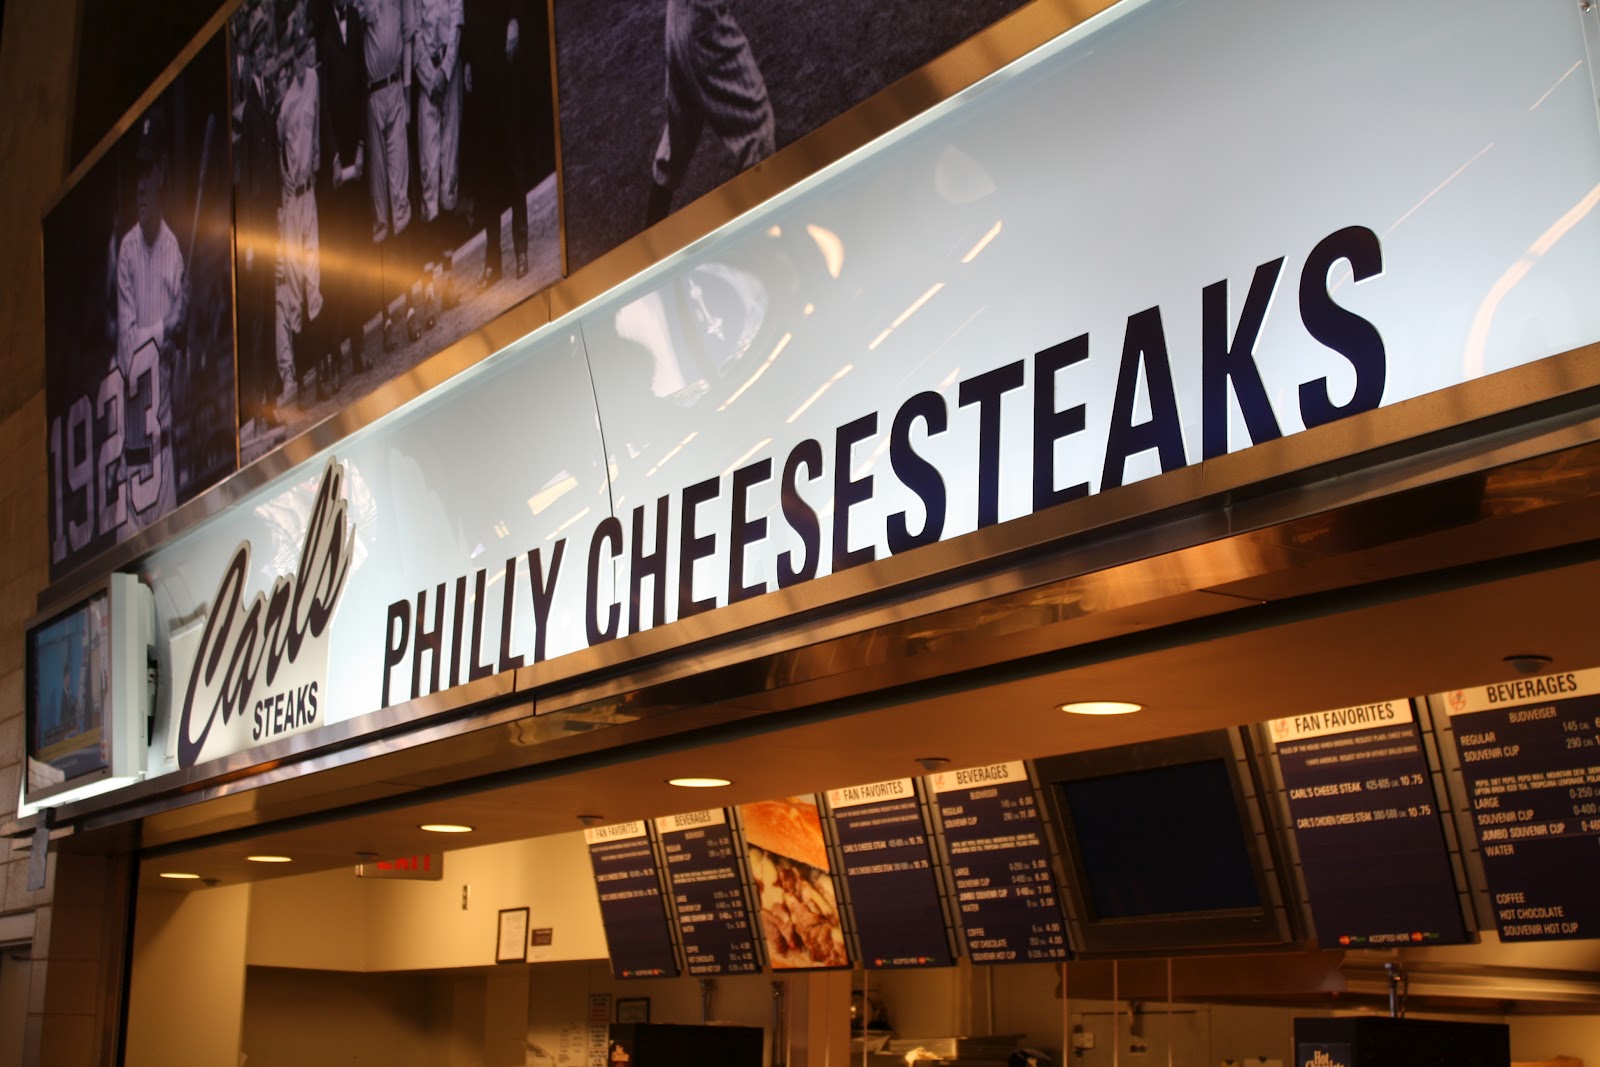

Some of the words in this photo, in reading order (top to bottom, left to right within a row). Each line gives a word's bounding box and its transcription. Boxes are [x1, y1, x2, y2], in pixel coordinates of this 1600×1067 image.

[51, 338, 161, 565] 1923
[381, 537, 567, 709] PHILLY
[586, 225, 1386, 647] CHEESESTEAKS
[178, 456, 355, 769] Carl's
[1486, 673, 1577, 703] BEVERAGES
[252, 682, 319, 741] STEAKS
[1295, 715, 1321, 733] FAN
[1324, 703, 1394, 728] FAVORITES
[1509, 706, 1557, 723] BUDWEISER
[1460, 732, 1496, 746] REGULAR
[1563, 720, 1578, 732] 145
[1464, 747, 1502, 762] SOUVENIR
[1503, 745, 1520, 757] CUP
[956, 764, 1008, 784] BEVERAGES
[843, 788, 860, 801] FAN
[861, 781, 903, 798] FAVORITES
[1290, 788, 1313, 800] CARL'S
[1314, 785, 1339, 797] CHEESE
[1340, 782, 1362, 794] STEAK
[1474, 797, 1499, 809] LARGE
[674, 810, 711, 827] BEVERAGES
[1478, 811, 1517, 825] SOUVENIR
[1518, 810, 1534, 820] CUP
[595, 828, 607, 839] FAN
[608, 822, 639, 836] FAVORITES
[1482, 829, 1508, 841] JUMBO
[1509, 825, 1548, 839] SOUVENIR
[1549, 823, 1565, 835] CUP
[1485, 844, 1514, 856] WATER
[1496, 892, 1525, 904] COFFEE
[1500, 909, 1515, 920] HOT
[1517, 906, 1564, 919] CHOCOLATE
[1503, 924, 1542, 936] SOUVENIR
[1544, 923, 1560, 934] HOT
[1561, 922, 1578, 933] CUP
